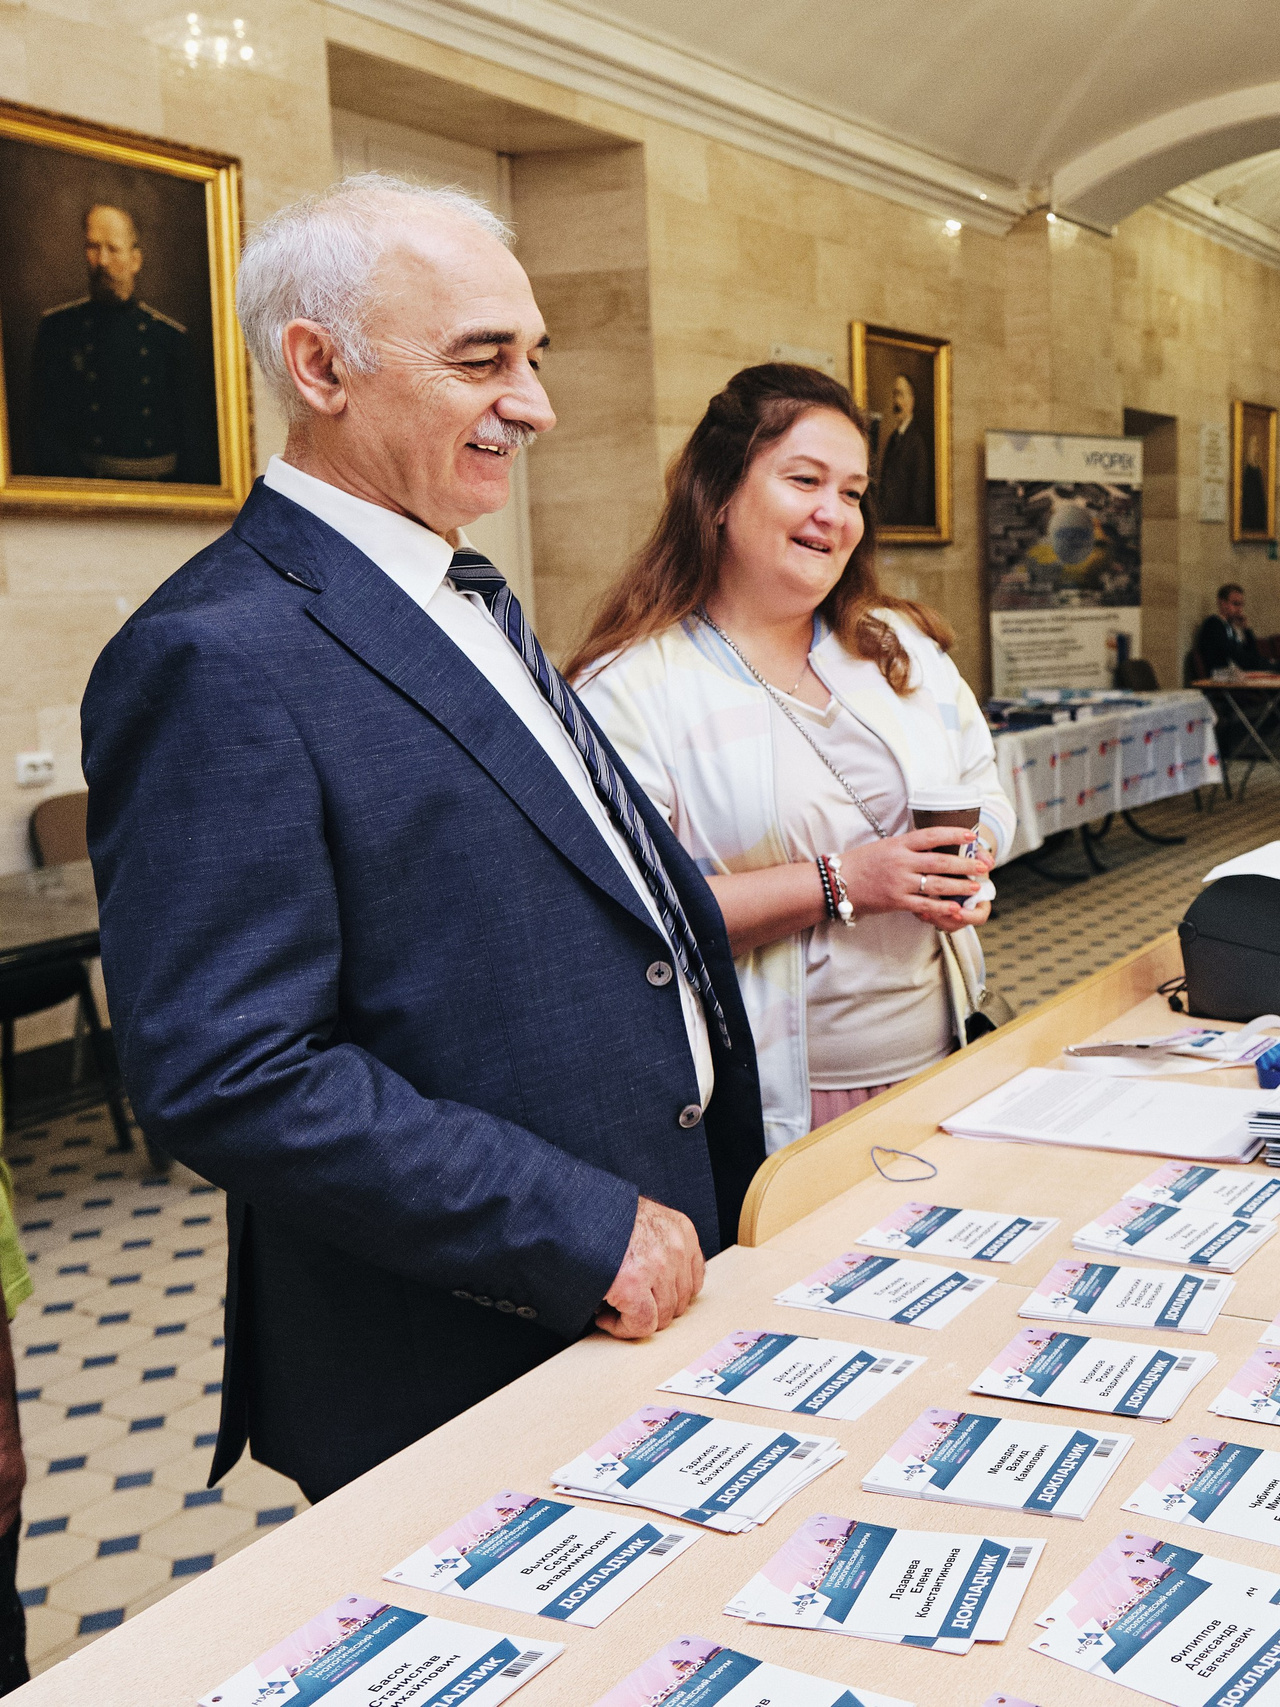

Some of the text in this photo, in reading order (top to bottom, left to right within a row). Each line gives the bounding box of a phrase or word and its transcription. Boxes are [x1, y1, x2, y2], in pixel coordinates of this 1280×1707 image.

[1164, 1281, 1198, 1321] ДОКЛАДЧИК
[805, 1360, 868, 1410] ДОКЛАДЧИК
[1124, 1358, 1171, 1408] ДОКЛАДЧИК
[717, 1443, 790, 1504] ДОКЛАДЧИК
[987, 1442, 1019, 1475] Мамедов
[1005, 1449, 1030, 1473] Вахид
[1013, 1444, 1050, 1482] Камалович
[1036, 1442, 1090, 1503] ДОКЛАДЧИК
[1248, 1478, 1280, 1510] Чибичян
[520, 1533, 578, 1576] Выходцев
[536, 1530, 617, 1592] Владимирович
[543, 1541, 584, 1571] Сергей
[557, 1537, 651, 1610] ДОКЛАДЧИК
[1163, 1552, 1178, 1566] ОРУМ
[889, 1559, 921, 1601] Лазарева
[910, 1566, 934, 1595] Елена
[915, 1547, 962, 1619] Константиновна
[951, 1553, 1001, 1630] ДОКЛАДЧИК
[1121, 1603, 1148, 1627] НЕВСКИЙ
[1123, 1579, 1186, 1634] УРОЛОГИЧЕСКИЙ ФОРУМ
[1075, 1639, 1093, 1655] НУФ
[1170, 1618, 1223, 1665] Филиппов
[1185, 1622, 1239, 1672] Александр
[1197, 1626, 1257, 1679] Евгеньевич
[367, 1662, 413, 1693] Басок
[368, 1655, 441, 1707] Станислав
[390, 1654, 462, 1707] ихайлович
[708, 1659, 734, 1680] ФОРУМ
